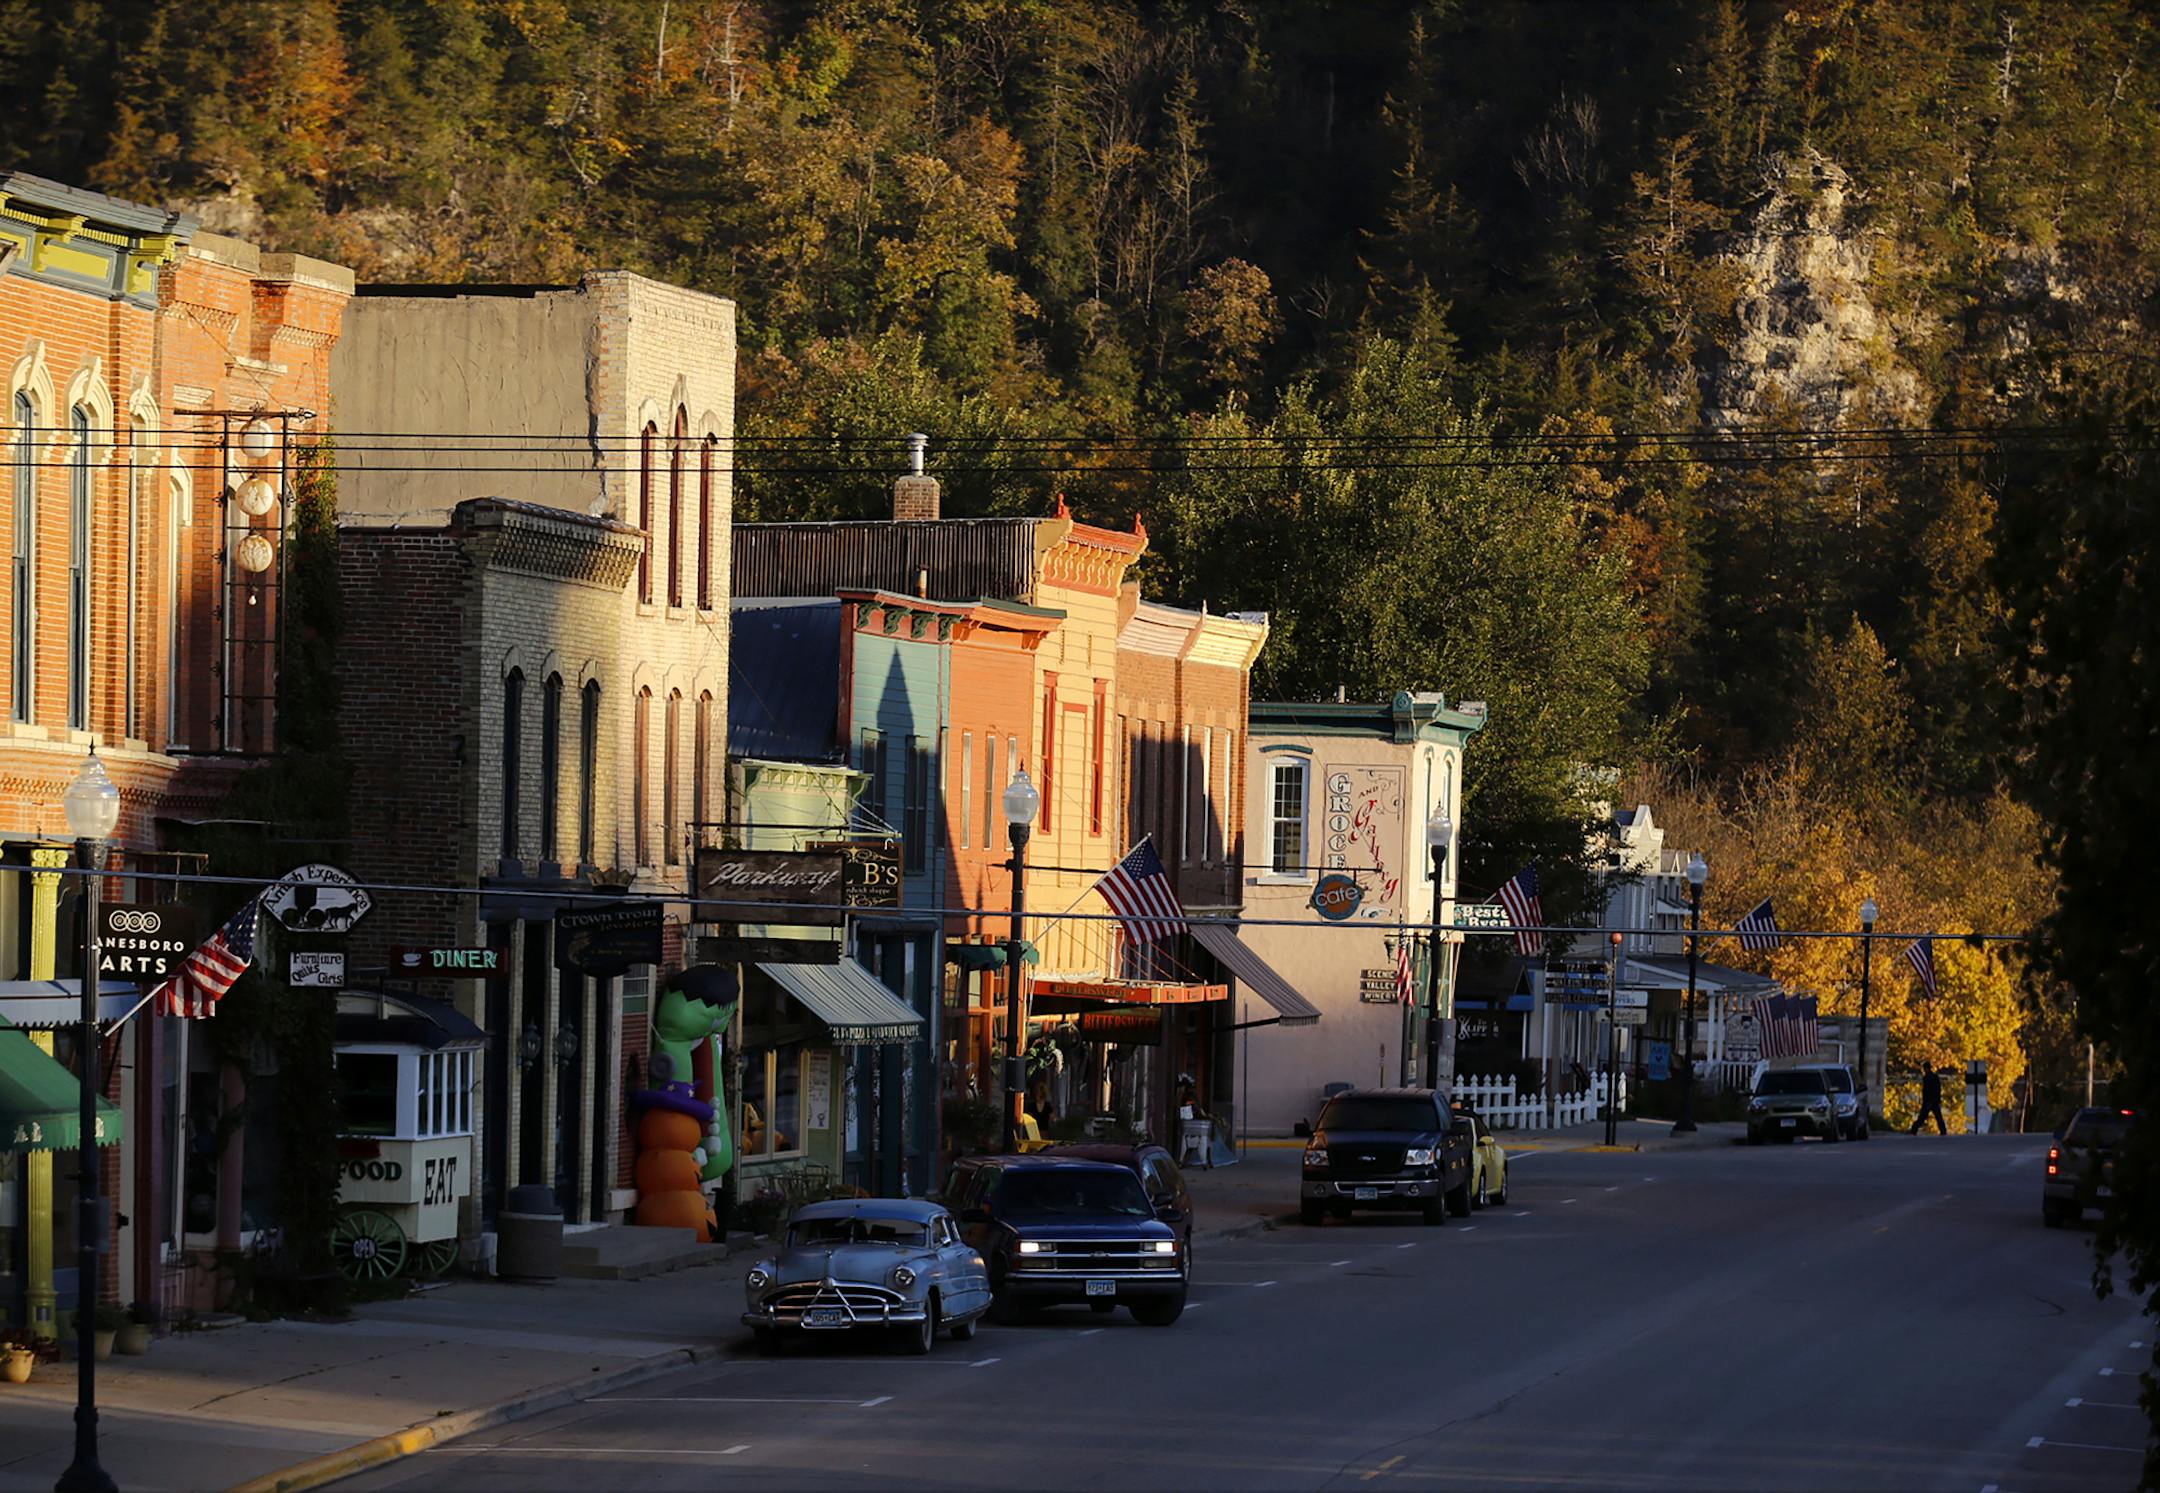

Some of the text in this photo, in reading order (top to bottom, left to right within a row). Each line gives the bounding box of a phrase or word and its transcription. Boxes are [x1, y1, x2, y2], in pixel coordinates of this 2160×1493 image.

[1359, 786, 1379, 798] AND
[1328, 773, 1352, 870] GROCE
[708, 861, 840, 894] Parkway
[1315, 884, 1359, 908] cafe
[560, 911, 611, 929] Crown
[96, 936, 185, 952] ANESBORO
[100, 955, 167, 974] ARTS
[294, 952, 341, 964] Furniture
[430, 949, 497, 968] DINER
[293, 965, 320, 981] Quilts
[319, 972, 343, 984] Gifts
[1367, 970, 1396, 979] SCENIC
[1366, 981, 1396, 990] VALLEY
[1364, 992, 1396, 1000] WINERY
[337, 1160, 402, 1181] FOOD
[424, 1156, 457, 1205] EAT
